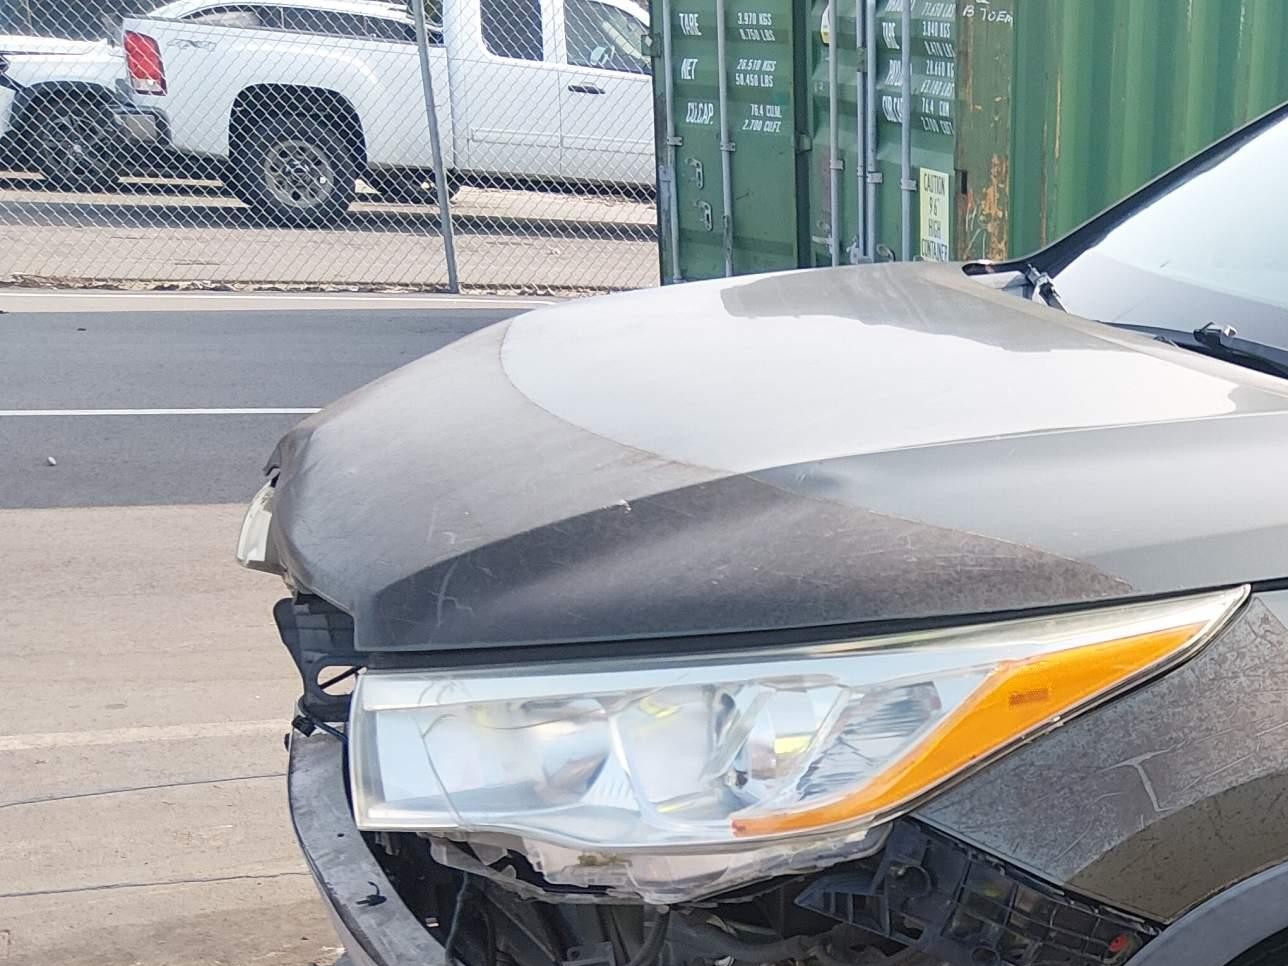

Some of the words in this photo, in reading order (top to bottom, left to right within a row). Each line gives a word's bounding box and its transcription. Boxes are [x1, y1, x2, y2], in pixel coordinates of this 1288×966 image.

[758, 13, 773, 25] KGS
[761, 30, 776, 41] LBS
[681, 58, 699, 80] NET
[761, 60, 777, 72] KGS
[760, 75, 774, 87] LBS
[923, 173, 946, 195] CAUTION
[928, 218, 941, 239] HIGH
